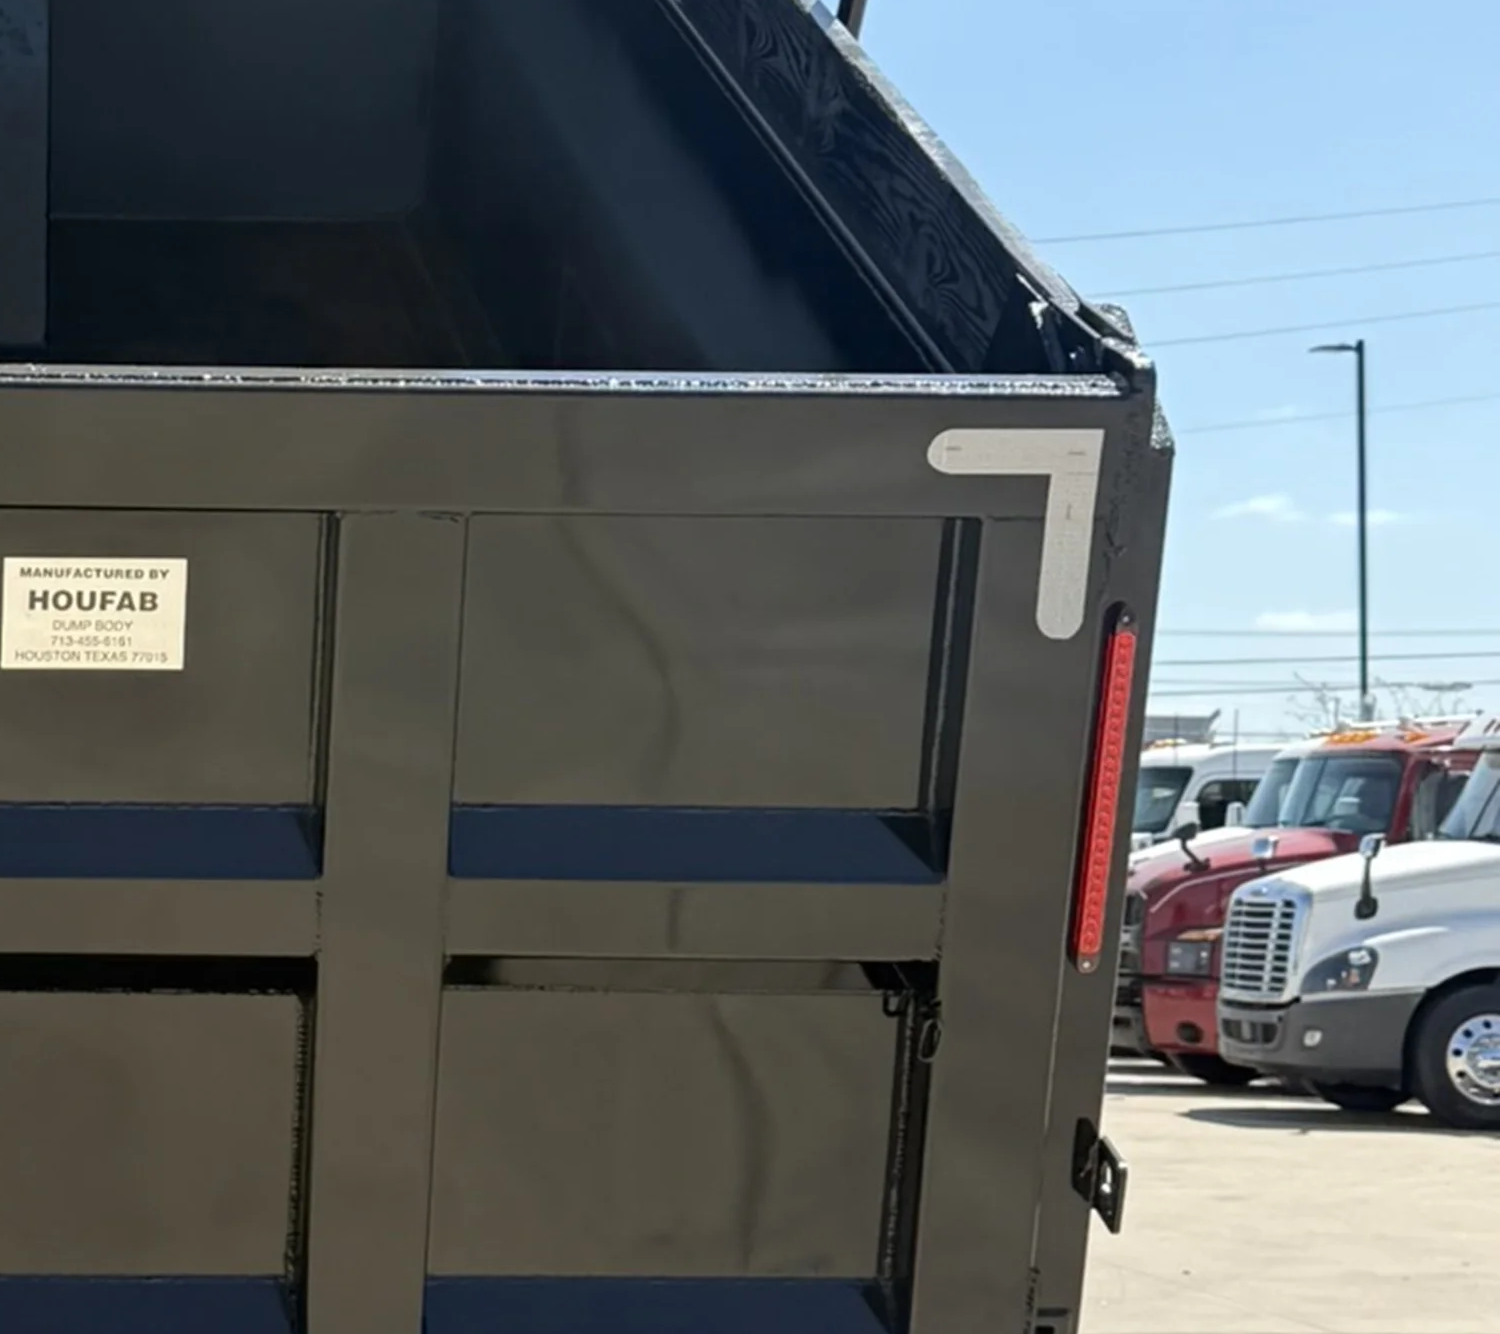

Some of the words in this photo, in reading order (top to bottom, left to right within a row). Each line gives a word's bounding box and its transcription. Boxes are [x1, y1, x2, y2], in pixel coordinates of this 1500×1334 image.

[19, 566, 145, 580] MANUFACTURED
[148, 568, 170, 580] BY
[28, 589, 159, 612] HOUFAB
[51, 619, 92, 632] DUMP
[94, 619, 134, 632] BODY
[14, 650, 81, 662] HOUSTON
[84, 651, 128, 663] TEXAS
